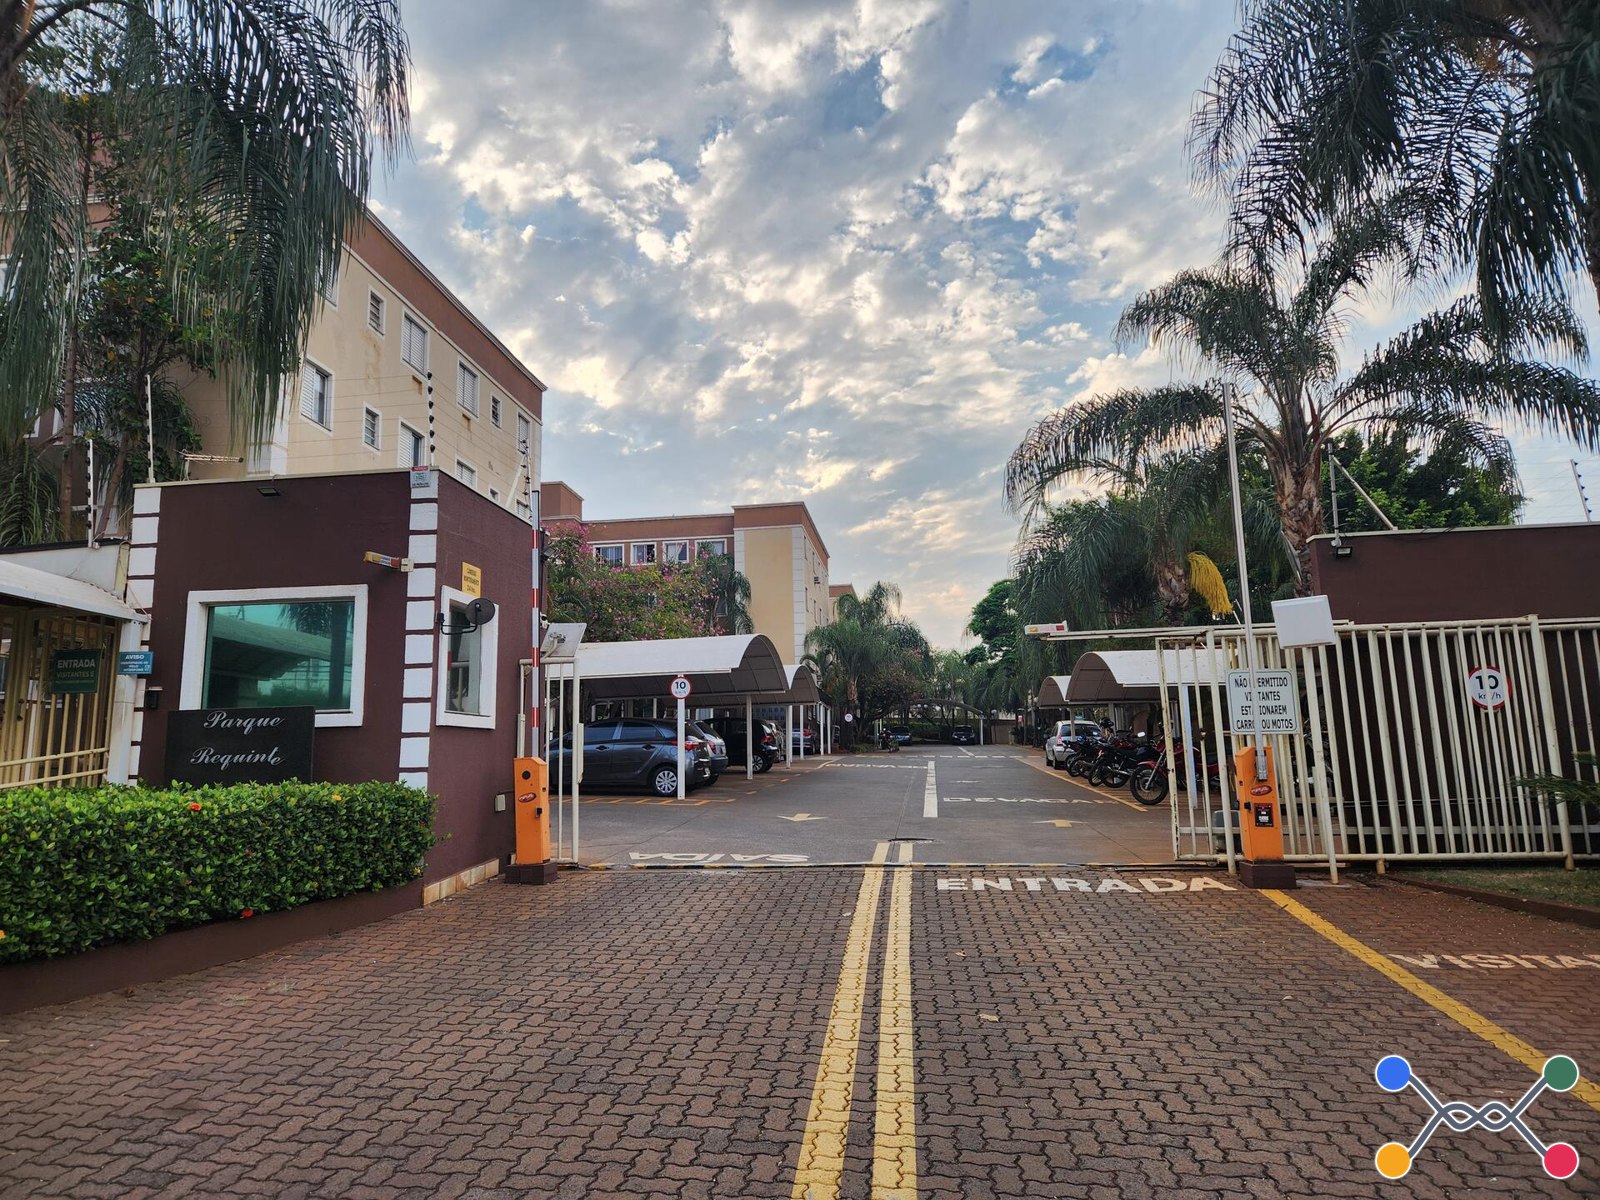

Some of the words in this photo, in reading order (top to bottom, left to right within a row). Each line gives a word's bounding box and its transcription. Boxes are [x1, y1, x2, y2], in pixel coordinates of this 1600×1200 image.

[57, 658, 96, 669] ENTRADA
[56, 670, 90, 678] VISITANTES
[675, 681, 686, 690] 10
[1234, 675, 1248, 688] NÃO
[1256, 677, 1288, 688] ERMITIDO
[1475, 674, 1499, 690] 10
[1244, 691, 1281, 702] VITANTES
[1240, 705, 1288, 716] ESTIONAREM
[203, 710, 285, 735] Parque
[1261, 719, 1271, 729] OU
[1271, 718, 1294, 729] MOTOS
[190, 746, 285, 771] Requinte
[937, 876, 1238, 893] ENTRADA
